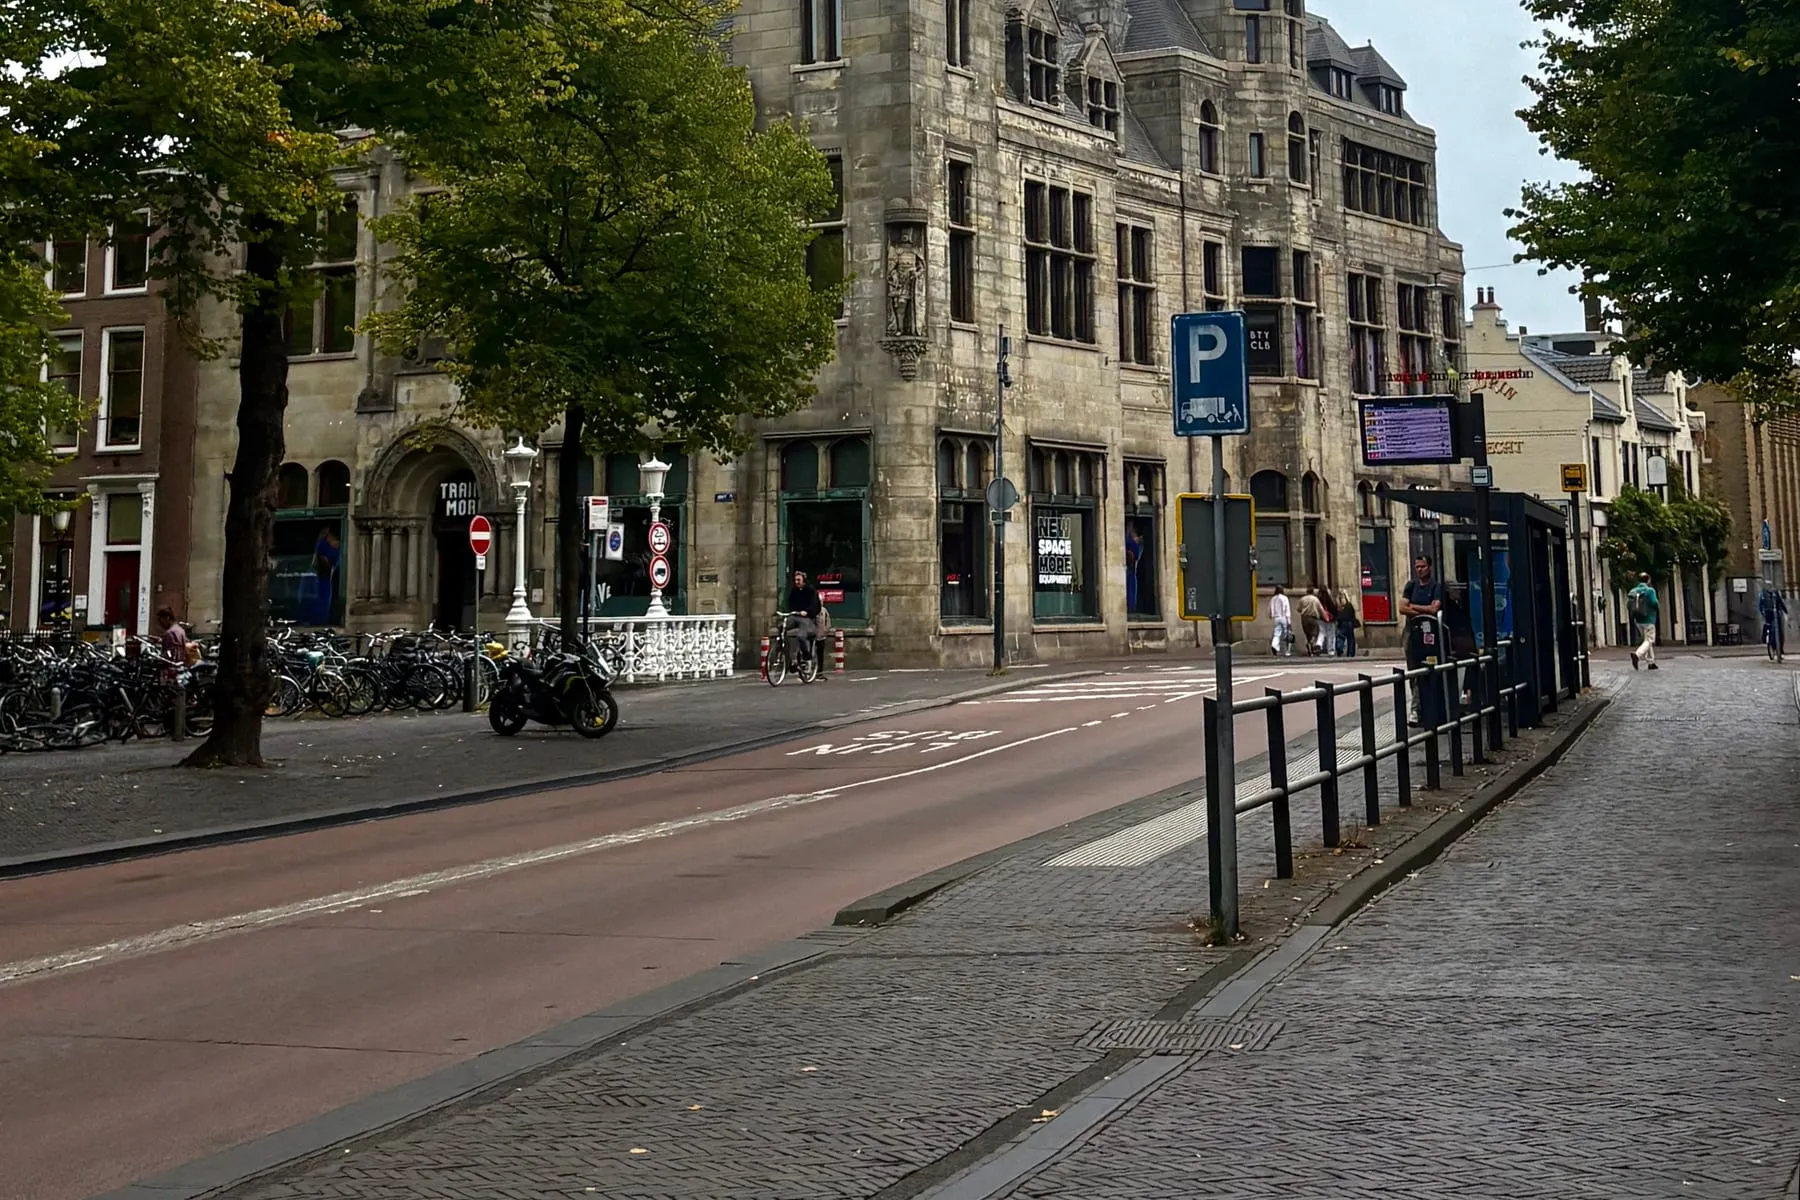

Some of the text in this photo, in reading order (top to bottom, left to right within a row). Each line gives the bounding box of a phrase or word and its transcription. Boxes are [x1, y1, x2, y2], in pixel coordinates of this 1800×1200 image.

[1249, 330, 1270, 340] BTY
[1250, 340, 1271, 350] CLB
[1188, 324, 1228, 384] P
[446, 499, 477, 517] MOR
[1037, 515, 1072, 539] NEW
[1038, 539, 1072, 555] SPACE
[1038, 555, 1073, 574] MORE
[1038, 574, 1073, 585] EQUIPMENT
